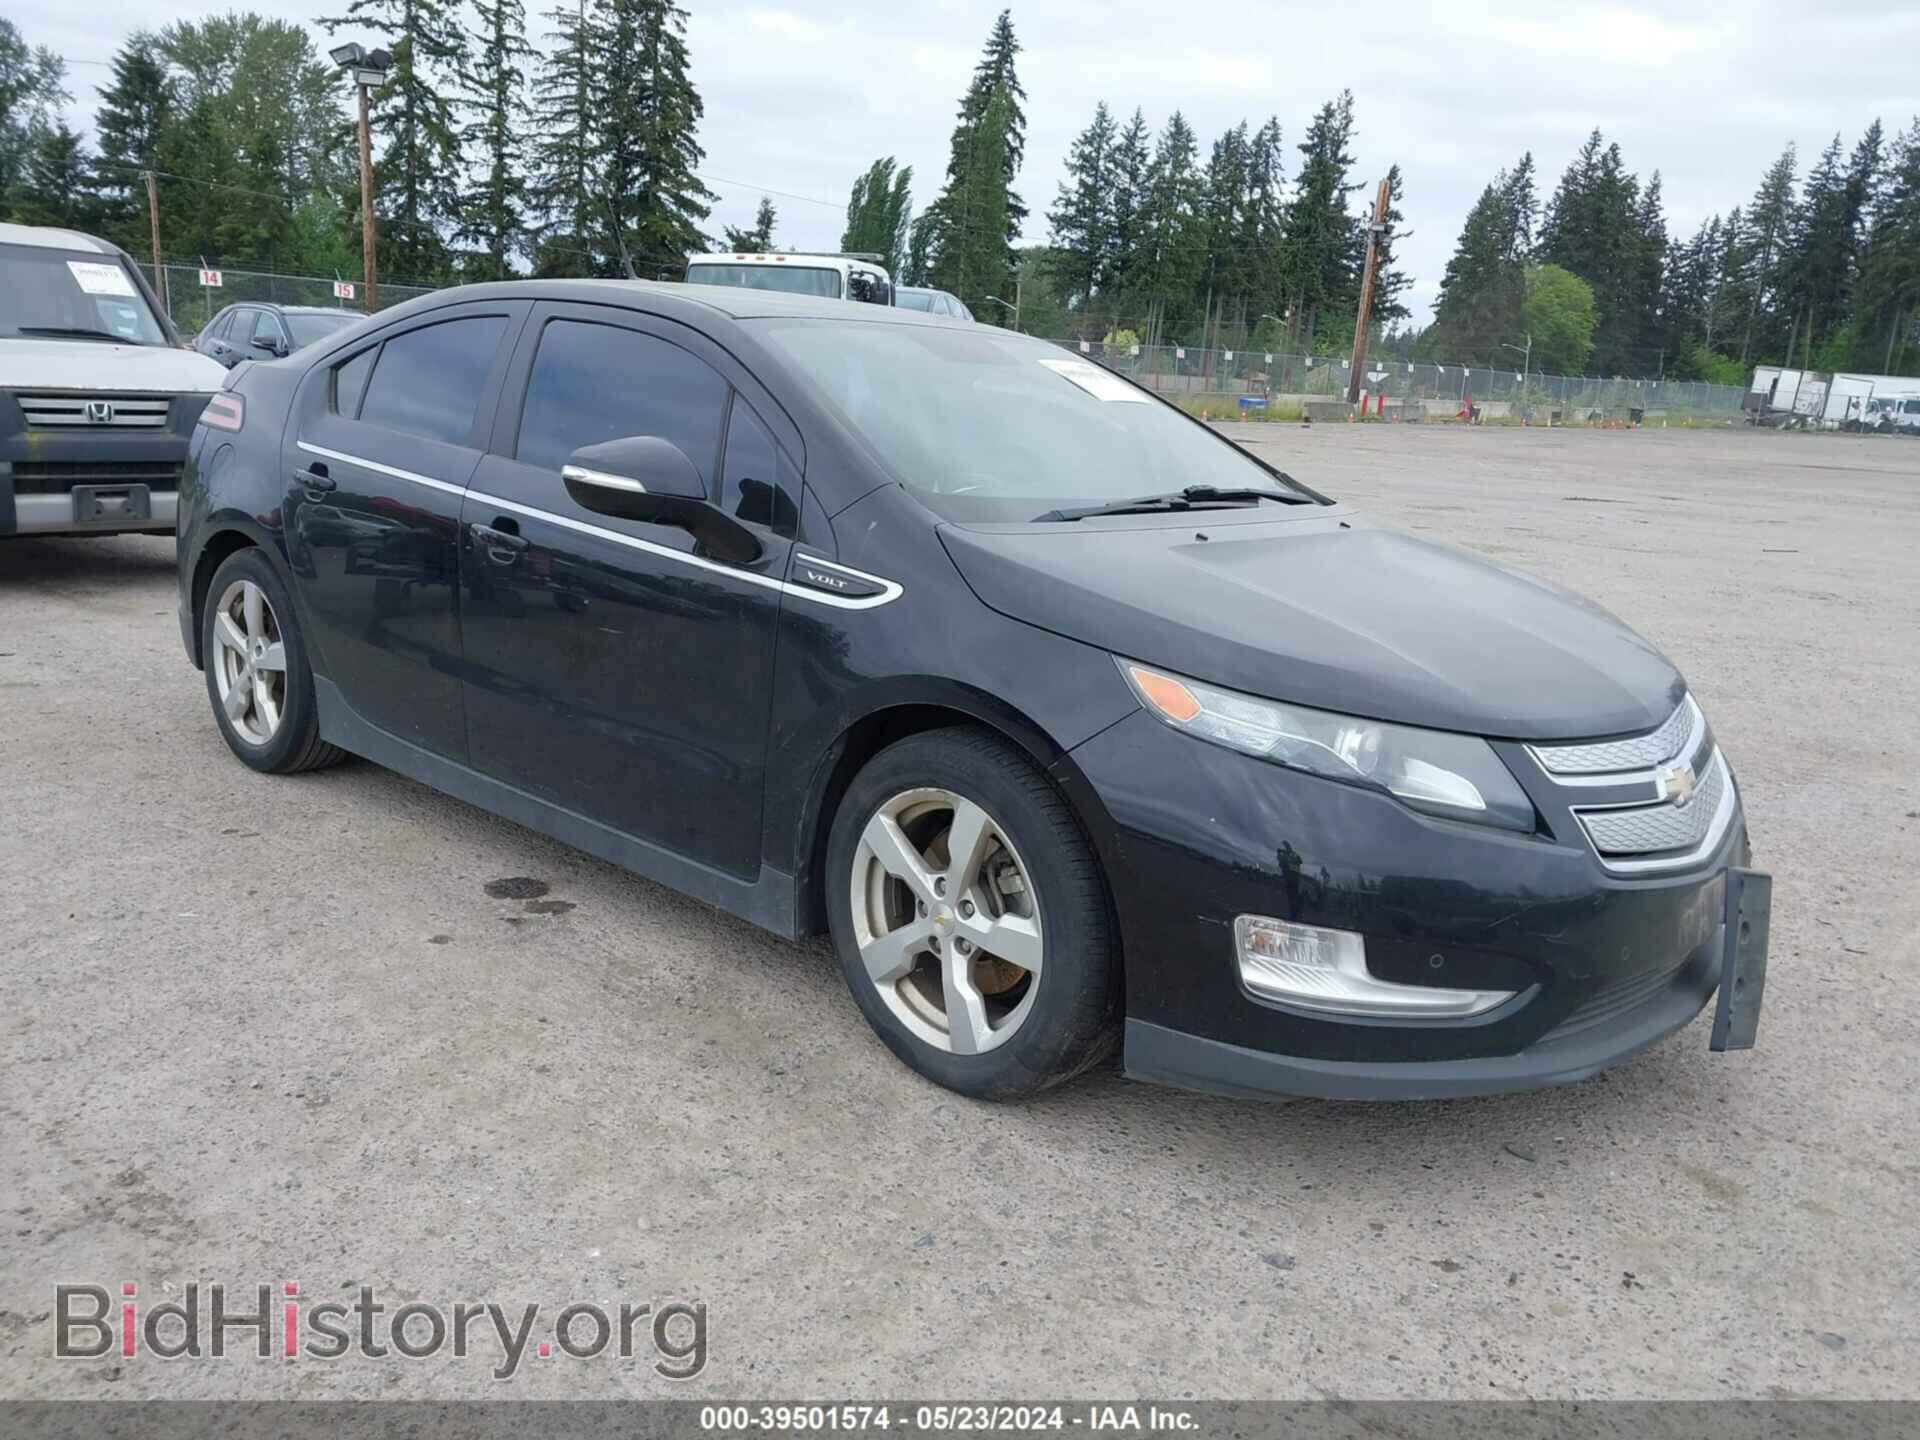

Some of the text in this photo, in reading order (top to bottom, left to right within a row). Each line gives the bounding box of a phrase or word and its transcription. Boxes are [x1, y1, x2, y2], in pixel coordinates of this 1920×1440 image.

[202, 271, 218, 285] 14
[337, 284, 351, 297] 15
[807, 570, 848, 588] VOLT
